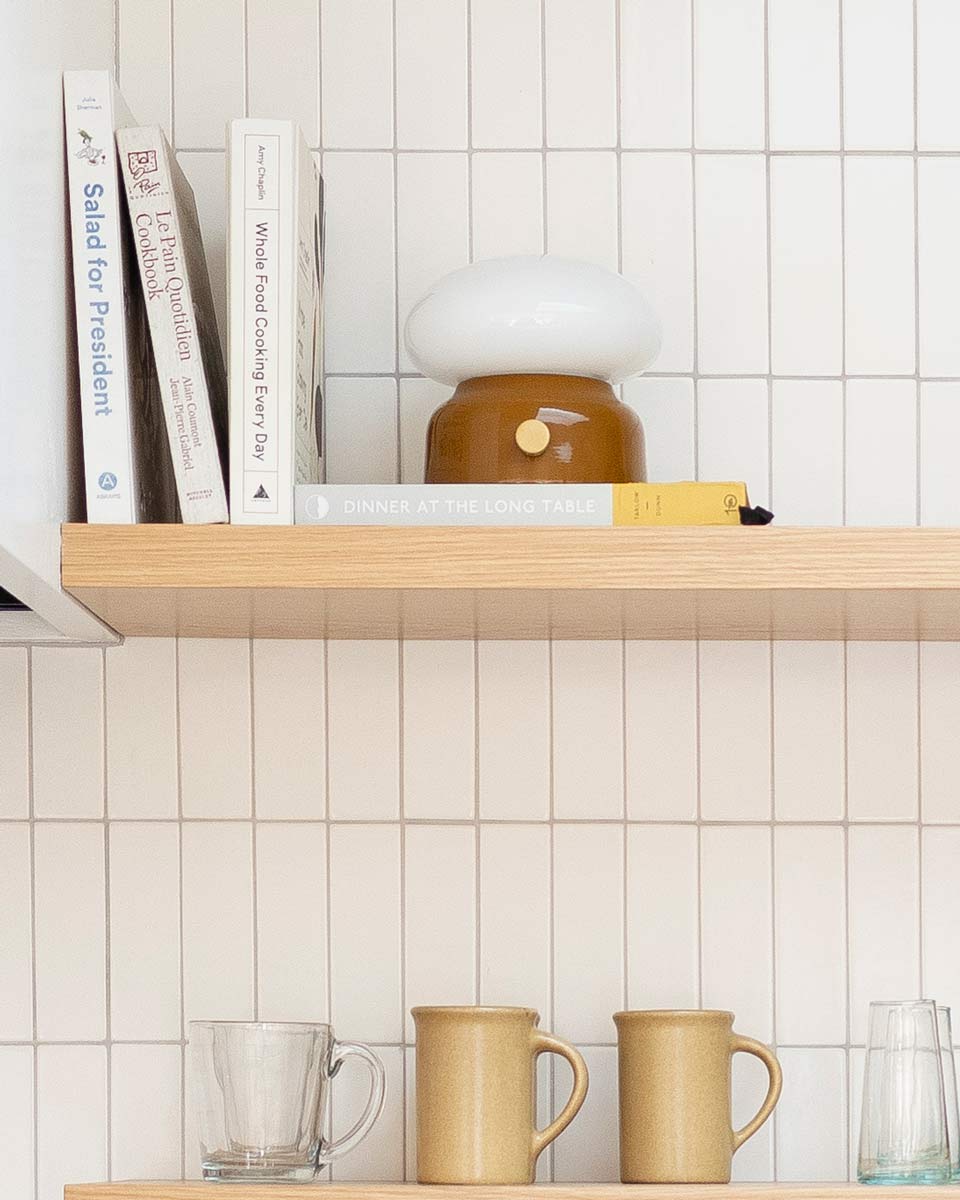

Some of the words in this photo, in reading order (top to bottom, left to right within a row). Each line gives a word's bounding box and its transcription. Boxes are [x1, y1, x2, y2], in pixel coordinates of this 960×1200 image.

[256, 144, 265, 165] Amy
[256, 167, 265, 201] Chaplin
[83, 182, 108, 250] Salad
[155, 209, 172, 233] Le
[135, 213, 162, 301] Cookbook
[160, 237, 176, 274] Pain
[256, 222, 268, 271] Whole
[87, 257, 109, 293] for
[255, 274, 268, 313] Food
[164, 277, 192, 362] Quotidien
[89, 301, 113, 416] President
[252, 317, 268, 381] Cooking
[181, 376, 193, 403] Alain
[252, 385, 268, 428] Every
[169, 377, 188, 435] Jean-Pierre
[180, 435, 194, 472] Gabriel
[251, 433, 268, 462] Day
[343, 498, 410, 514] DINNER
[417, 498, 439, 514] AT
[445, 498, 479, 514] THE
[484, 498, 536, 514] LONG
[541, 498, 596, 514] TABLE
